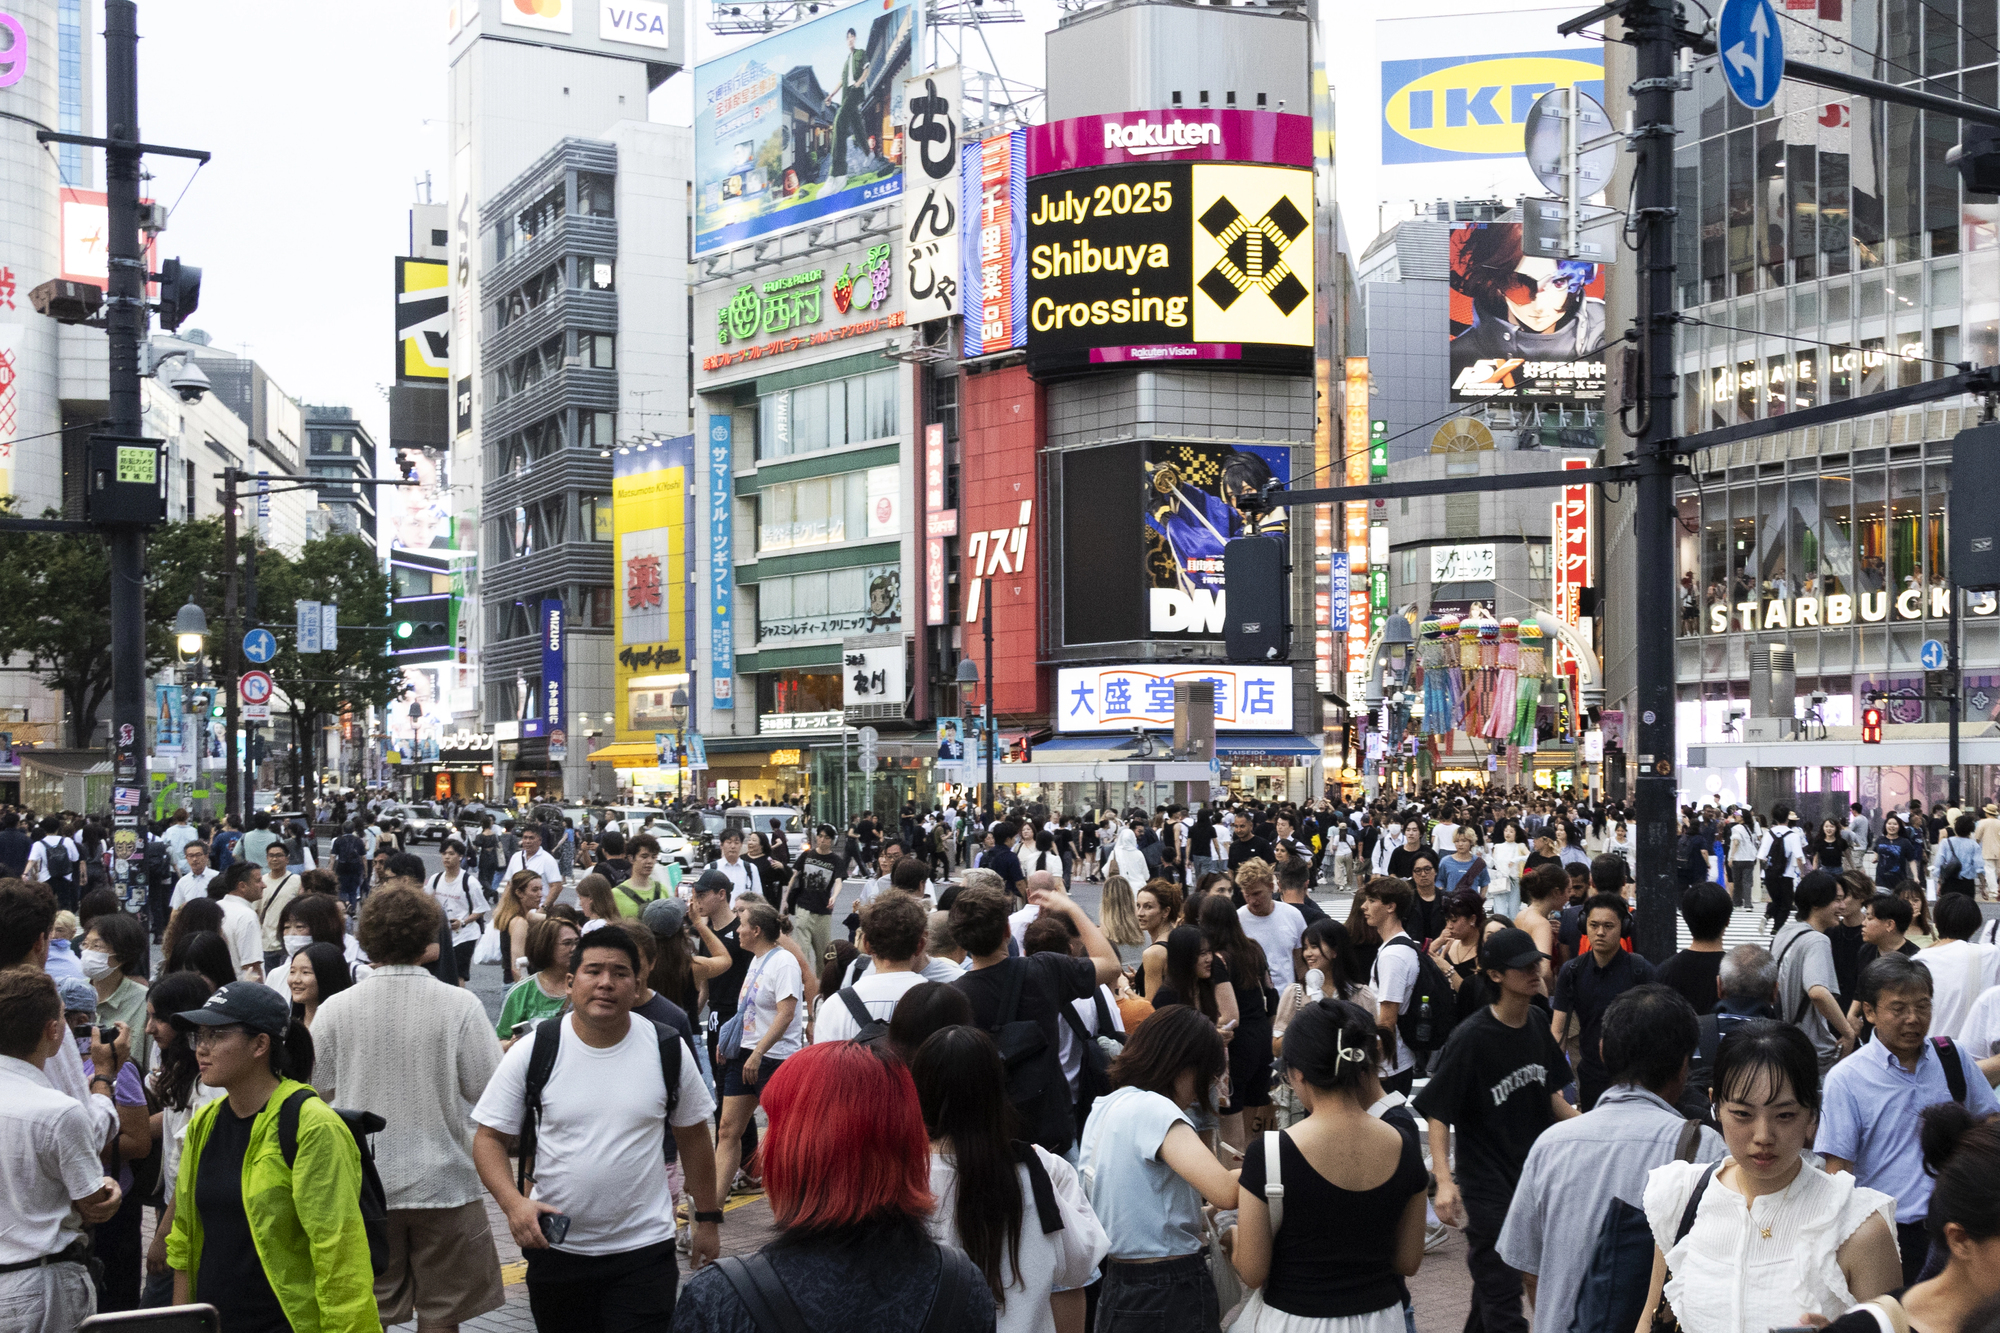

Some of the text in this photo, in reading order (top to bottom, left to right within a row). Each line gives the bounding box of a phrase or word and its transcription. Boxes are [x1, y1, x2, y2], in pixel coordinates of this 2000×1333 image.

[606, 7, 664, 35] VISA
[1409, 79, 1604, 130] IKE
[1104, 119, 1221, 149] Rakuten
[908, 78, 956, 311] もんじゃ
[1031, 181, 1173, 226] July 2025
[981, 144, 1004, 340] 三千里薬品
[1031, 238, 1170, 280] Shibuya
[762, 285, 822, 334] 西村
[1031, 287, 1189, 332] Crossing
[1131, 346, 1198, 359] Rakuten Vision
[458, 391, 470, 416] 7F
[120, 450, 154, 458] CCTV
[120, 465, 154, 473] POLICE
[618, 480, 681, 499] Matsumoto KiYoshi
[711, 446, 729, 598] サマーフルーツギフト
[1435, 564, 1494, 579] クリニック
[1449, 547, 1494, 563] れいわ
[627, 553, 661, 610] 薬
[1334, 557, 1347, 628] 大盛堂商事ビル
[550, 610, 560, 651] MIZUHO
[548, 680, 559, 725] みずほ銀行
